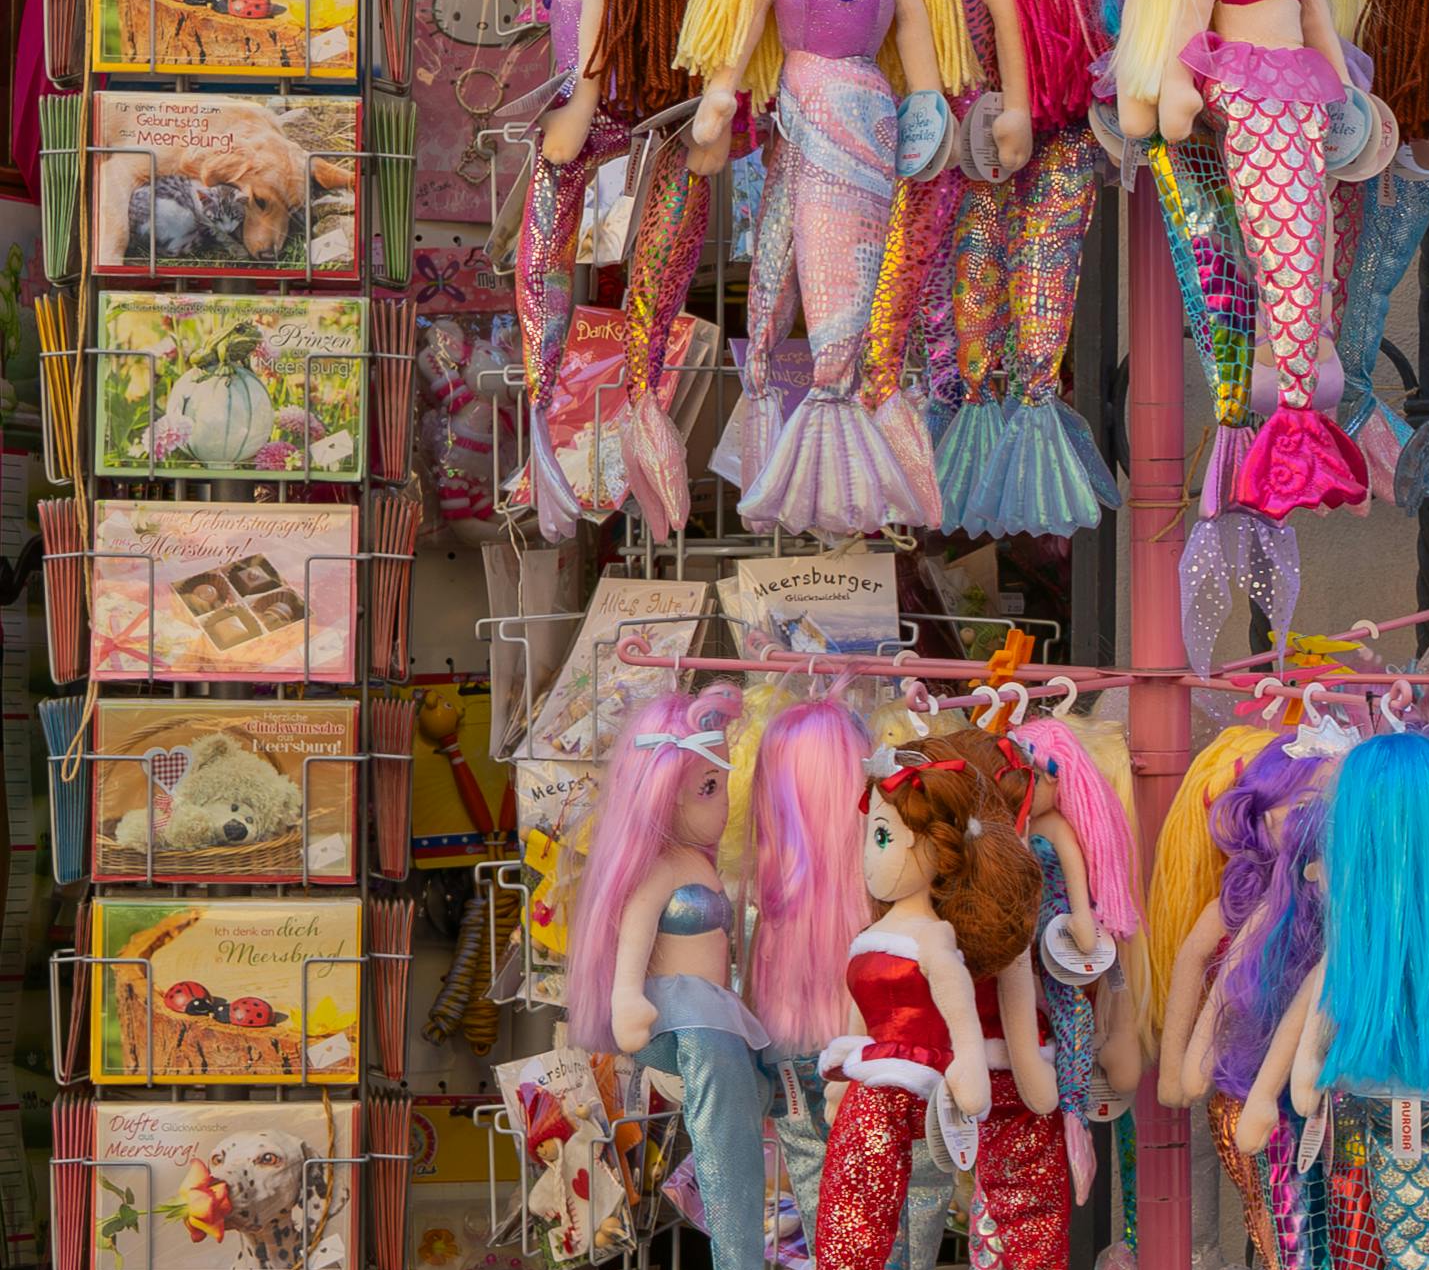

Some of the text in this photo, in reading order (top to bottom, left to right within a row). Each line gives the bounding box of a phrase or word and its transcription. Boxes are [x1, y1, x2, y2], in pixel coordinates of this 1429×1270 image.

[136, 113, 209, 131] Geburtstag
[137, 130, 234, 154] Meersburg!
[269, 323, 353, 351] Prinzen
[258, 358, 353, 379] Meerburg!
[130, 532, 253, 562] Meersburg!
[753, 566, 884, 600] Meersburger
[263, 711, 308, 722] Herzliche
[252, 739, 342, 755] Meersburg!
[214, 915, 321, 938] Ich denk an dich
[218, 939, 345, 978] Meersburg!
[110, 1112, 159, 1139] Dufte
[1401, 1101, 1412, 1151] AURORA
[104, 1141, 200, 1167] Meersburg!
